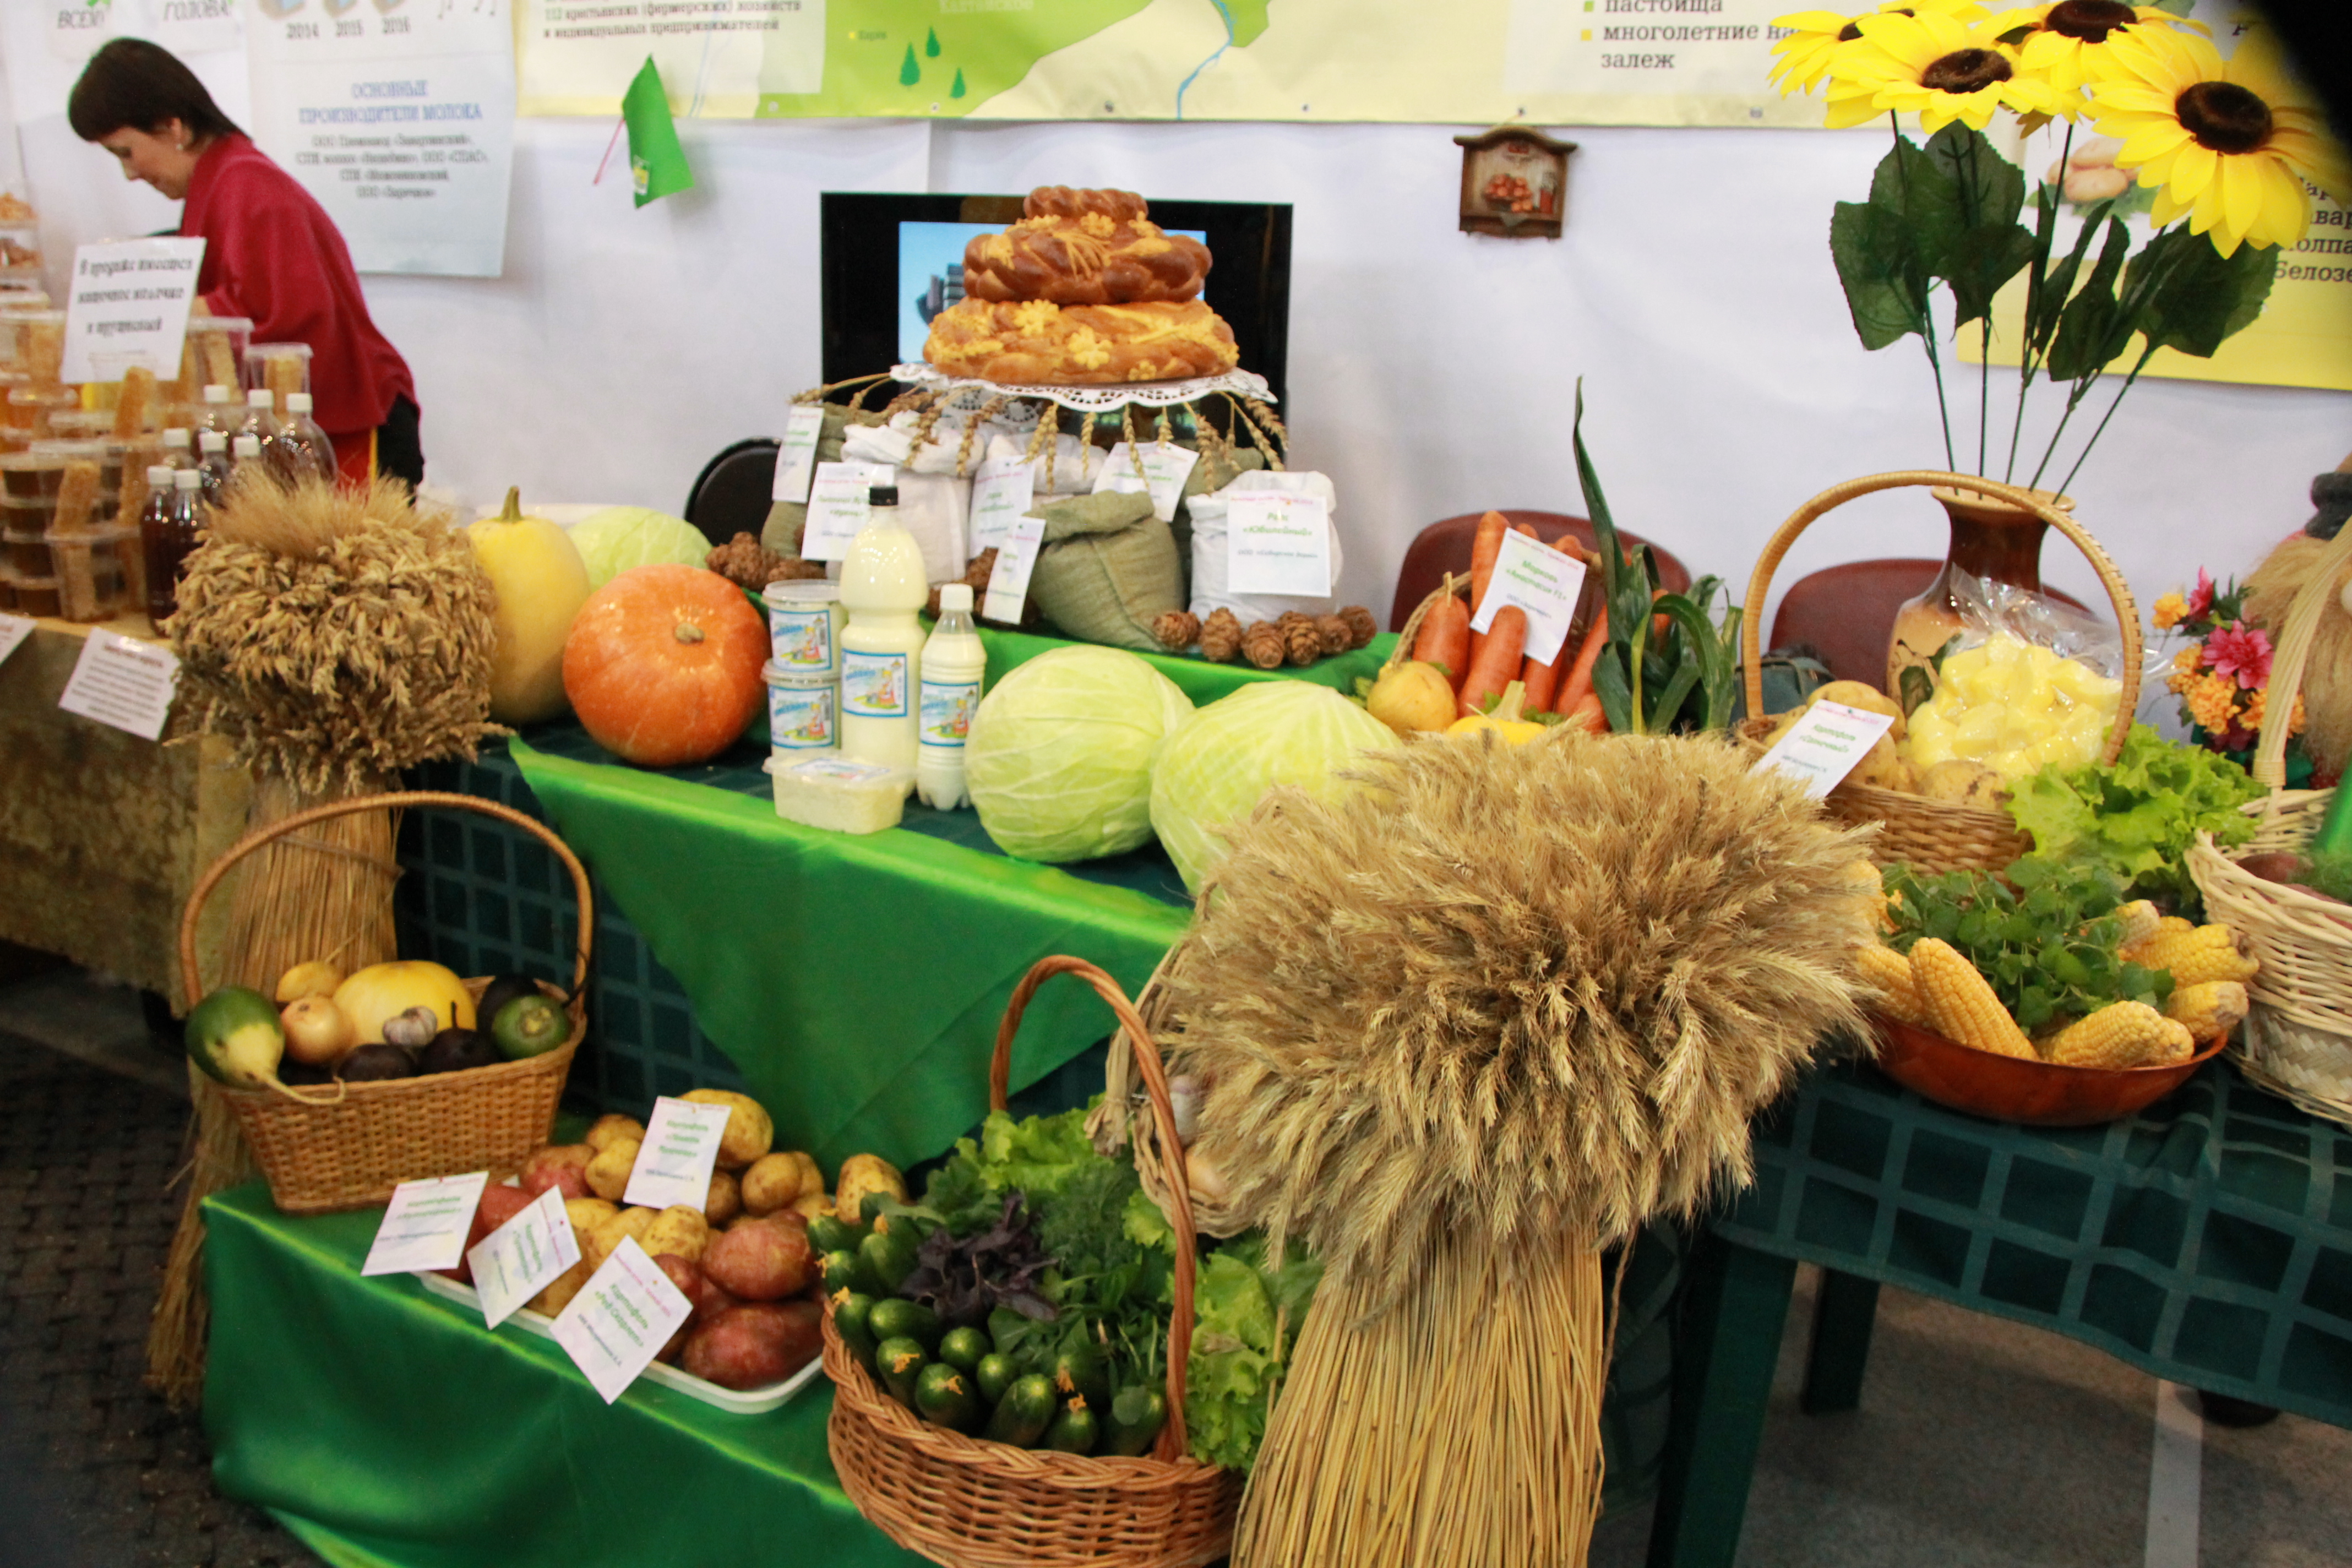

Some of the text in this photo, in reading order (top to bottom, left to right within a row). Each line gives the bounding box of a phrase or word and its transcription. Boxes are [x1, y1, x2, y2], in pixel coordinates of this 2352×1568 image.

[286, 22, 320, 39] 2014
[382, 16, 411, 34] 2016
[1604, 25, 1759, 41] многолетние
[1602, 53, 1675, 69] залеж
[352, 80, 428, 99] ОСНОВНЫЕ
[298, 103, 482, 124] ПРОИЗВОДИТЕЛИ МОЛОКА
[609, 1283, 650, 1330] Картофель
